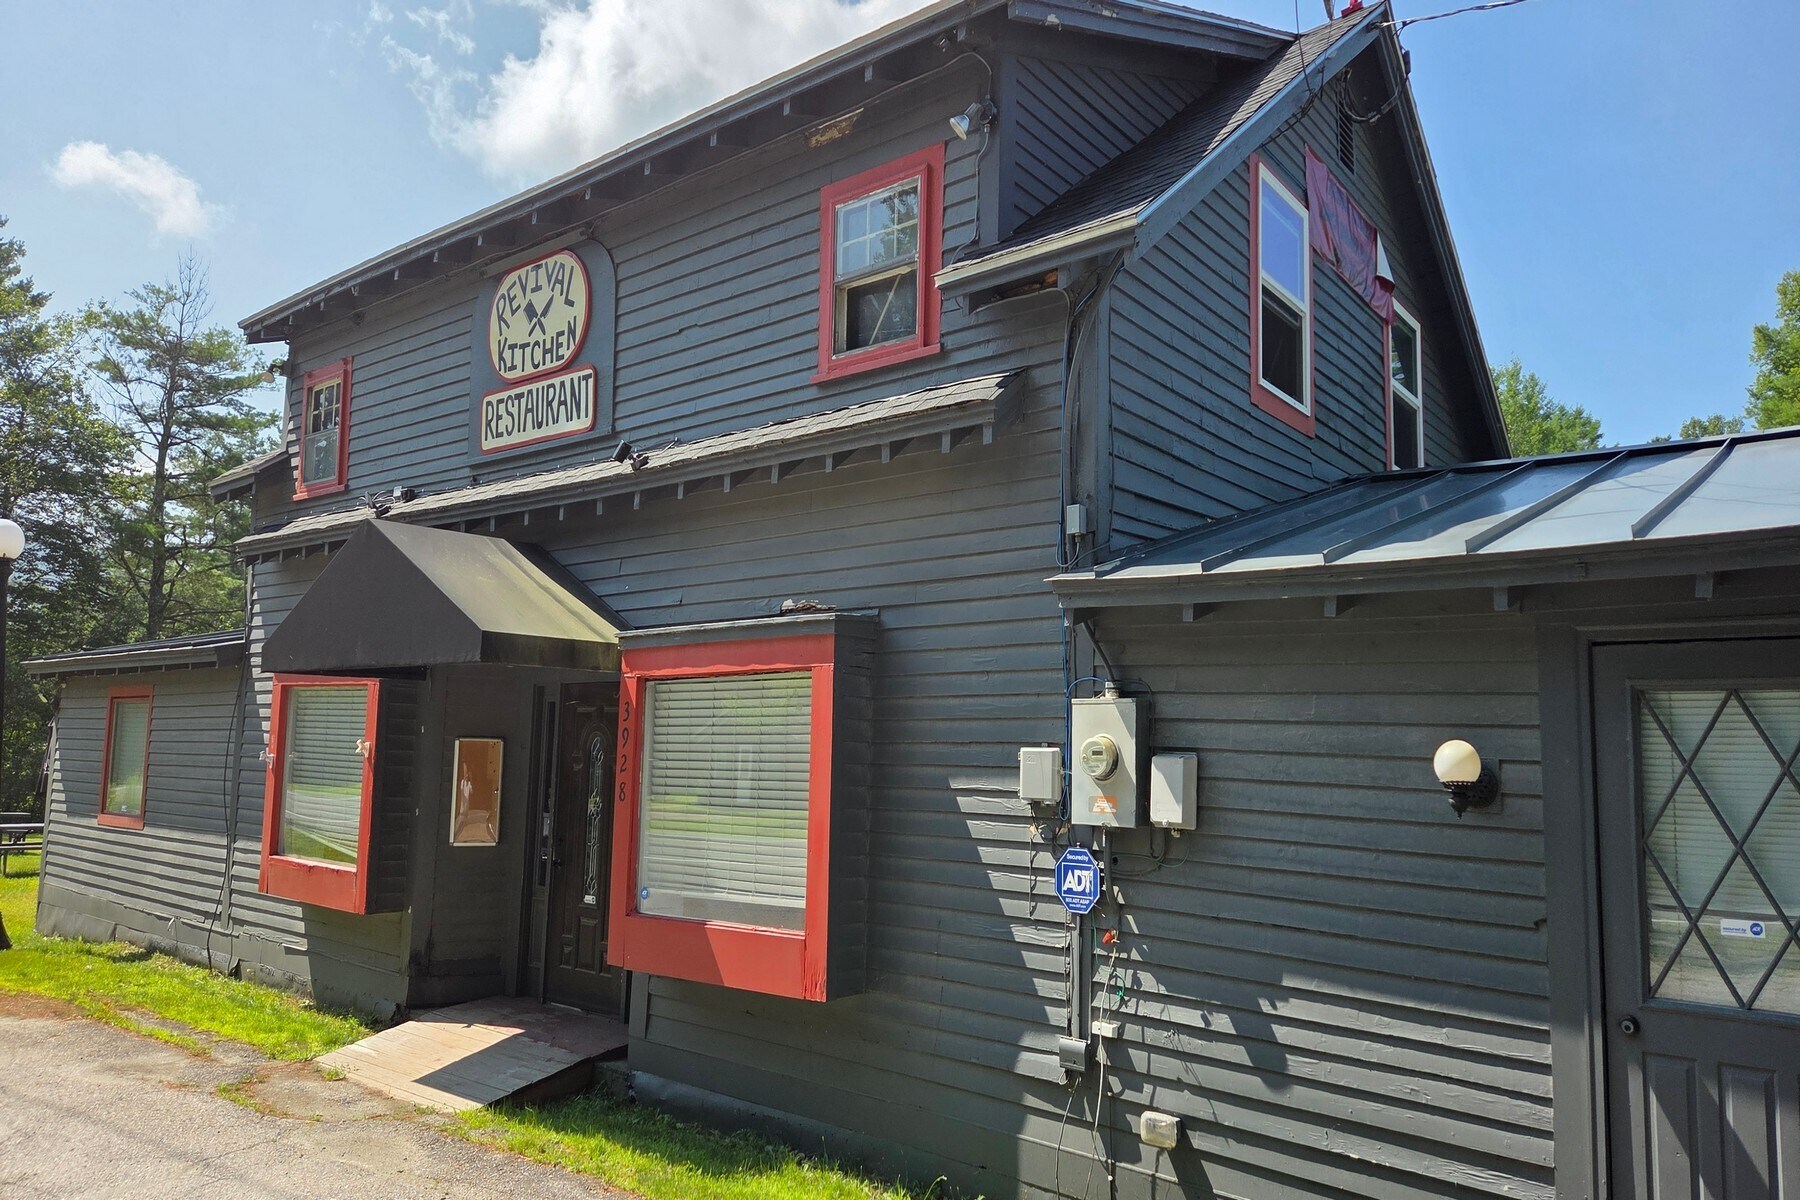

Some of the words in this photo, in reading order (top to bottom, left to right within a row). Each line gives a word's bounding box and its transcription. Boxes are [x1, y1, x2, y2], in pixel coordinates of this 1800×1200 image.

[496, 260, 575, 336] REVIVAL
[498, 315, 577, 373] KITCHEN
[485, 373, 592, 441] RESTAURANT
[619, 701, 630, 802] 3928
[1063, 869, 1092, 893] ADT
